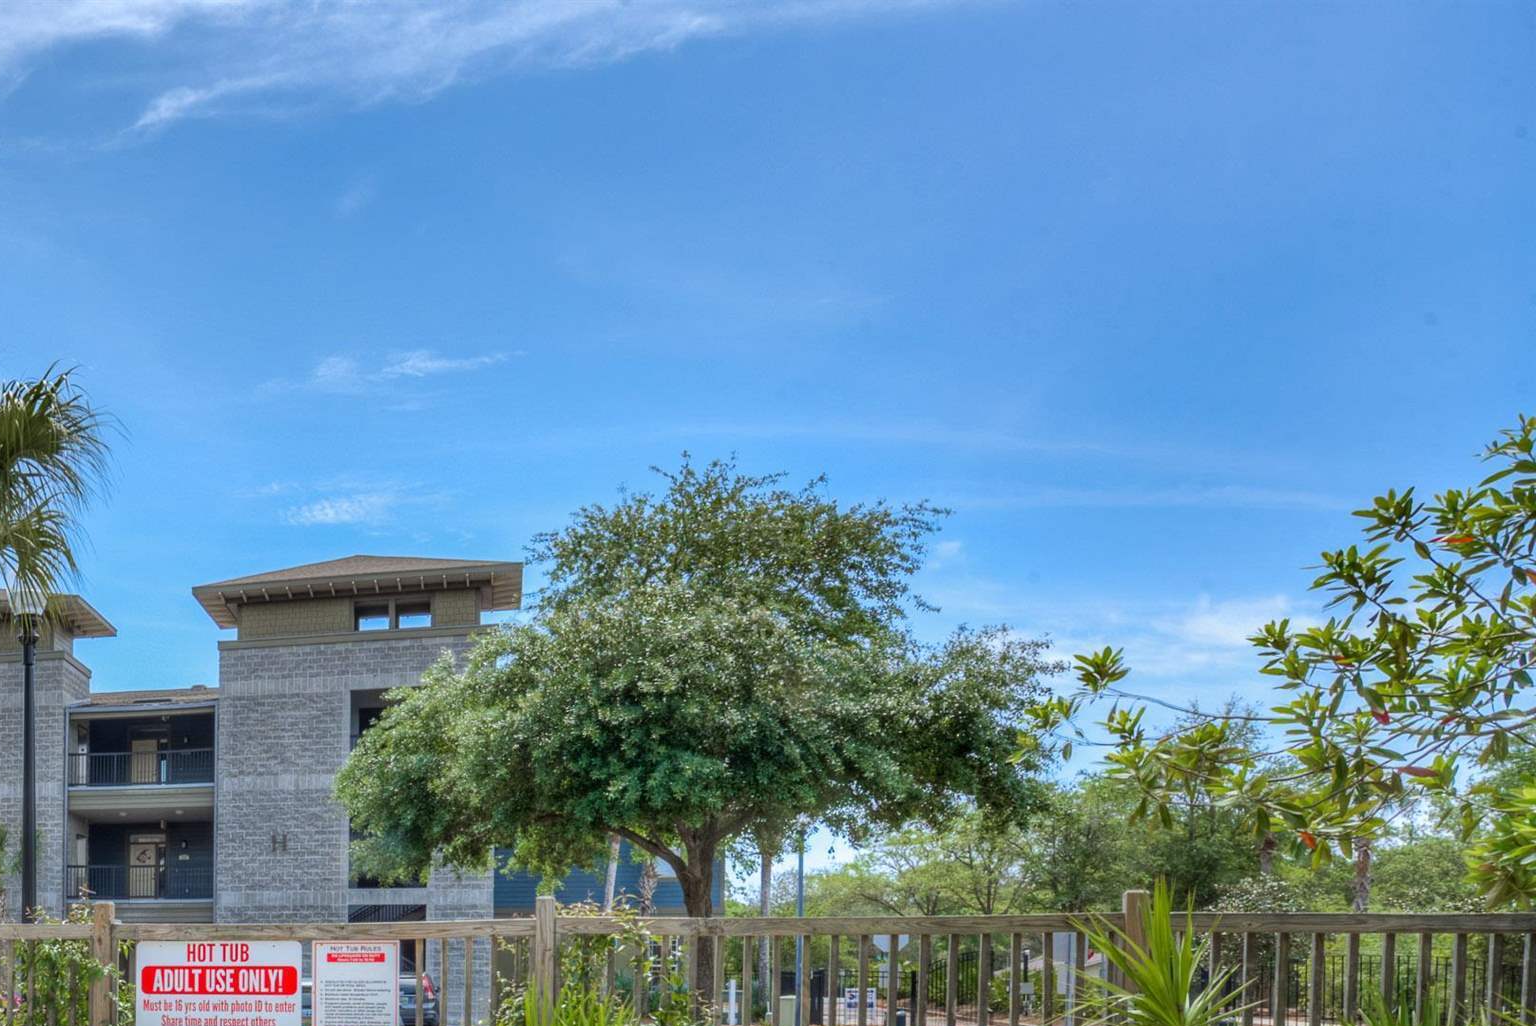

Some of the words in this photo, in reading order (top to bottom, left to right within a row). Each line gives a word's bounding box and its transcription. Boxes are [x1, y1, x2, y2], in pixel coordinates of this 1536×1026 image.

[271, 832, 288, 852] H
[187, 943, 215, 962] HOT
[220, 943, 249, 962] TUB
[152, 968, 202, 993] ADULT
[205, 968, 235, 993] USE
[238, 968, 284, 993] ONLY!
[144, 999, 162, 1012] Must
[164, 1000, 173, 1012] be
[175, 1000, 182, 1012] 16
[184, 1002, 196, 1014] yrs
[199, 1000, 210, 1012] old
[212, 1000, 229, 1012] with
[231, 1000, 253, 1014] photo
[255, 1000, 263, 1012] ID
[265, 1001, 273, 1012] to
[275, 1001, 296, 1013] enter
[161, 1015, 183, 1026] Share
[185, 1015, 202, 1026] time
